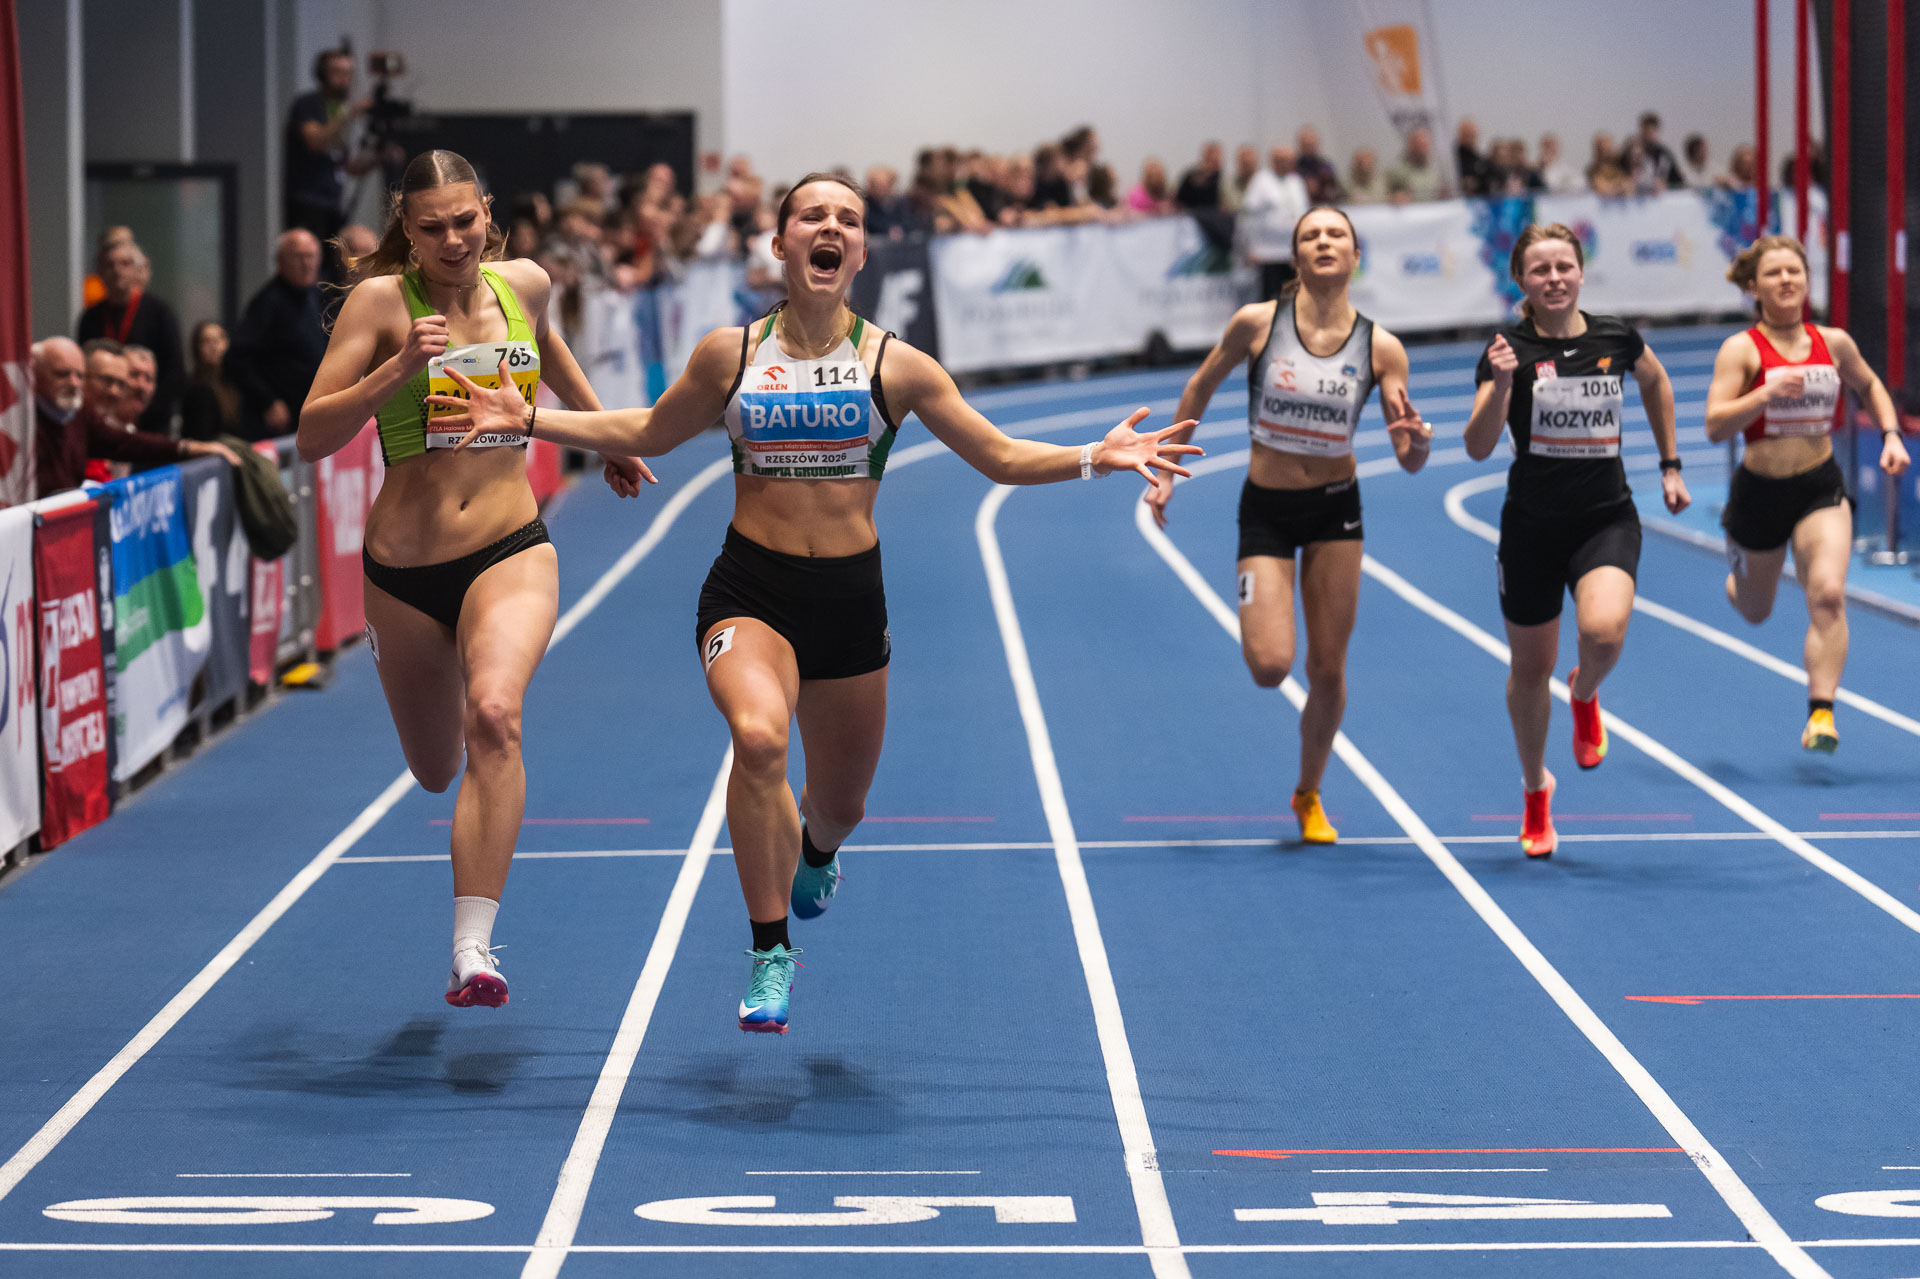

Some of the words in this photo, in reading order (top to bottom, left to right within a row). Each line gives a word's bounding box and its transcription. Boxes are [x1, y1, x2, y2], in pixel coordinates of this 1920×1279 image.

[495, 348, 531, 368] 765
[814, 366, 858, 387] 114
[757, 383, 788, 391] ORLEN
[1317, 379, 1348, 397] 136
[1581, 380, 1619, 397] 1010
[750, 403, 861, 429] BATURO
[1264, 396, 1347, 425] KOPYSTECKA
[1539, 409, 1614, 429] KOZYRA
[765, 453, 819, 464] RZESZÓW
[822, 453, 846, 463] 2026
[707, 631, 726, 663] 5
